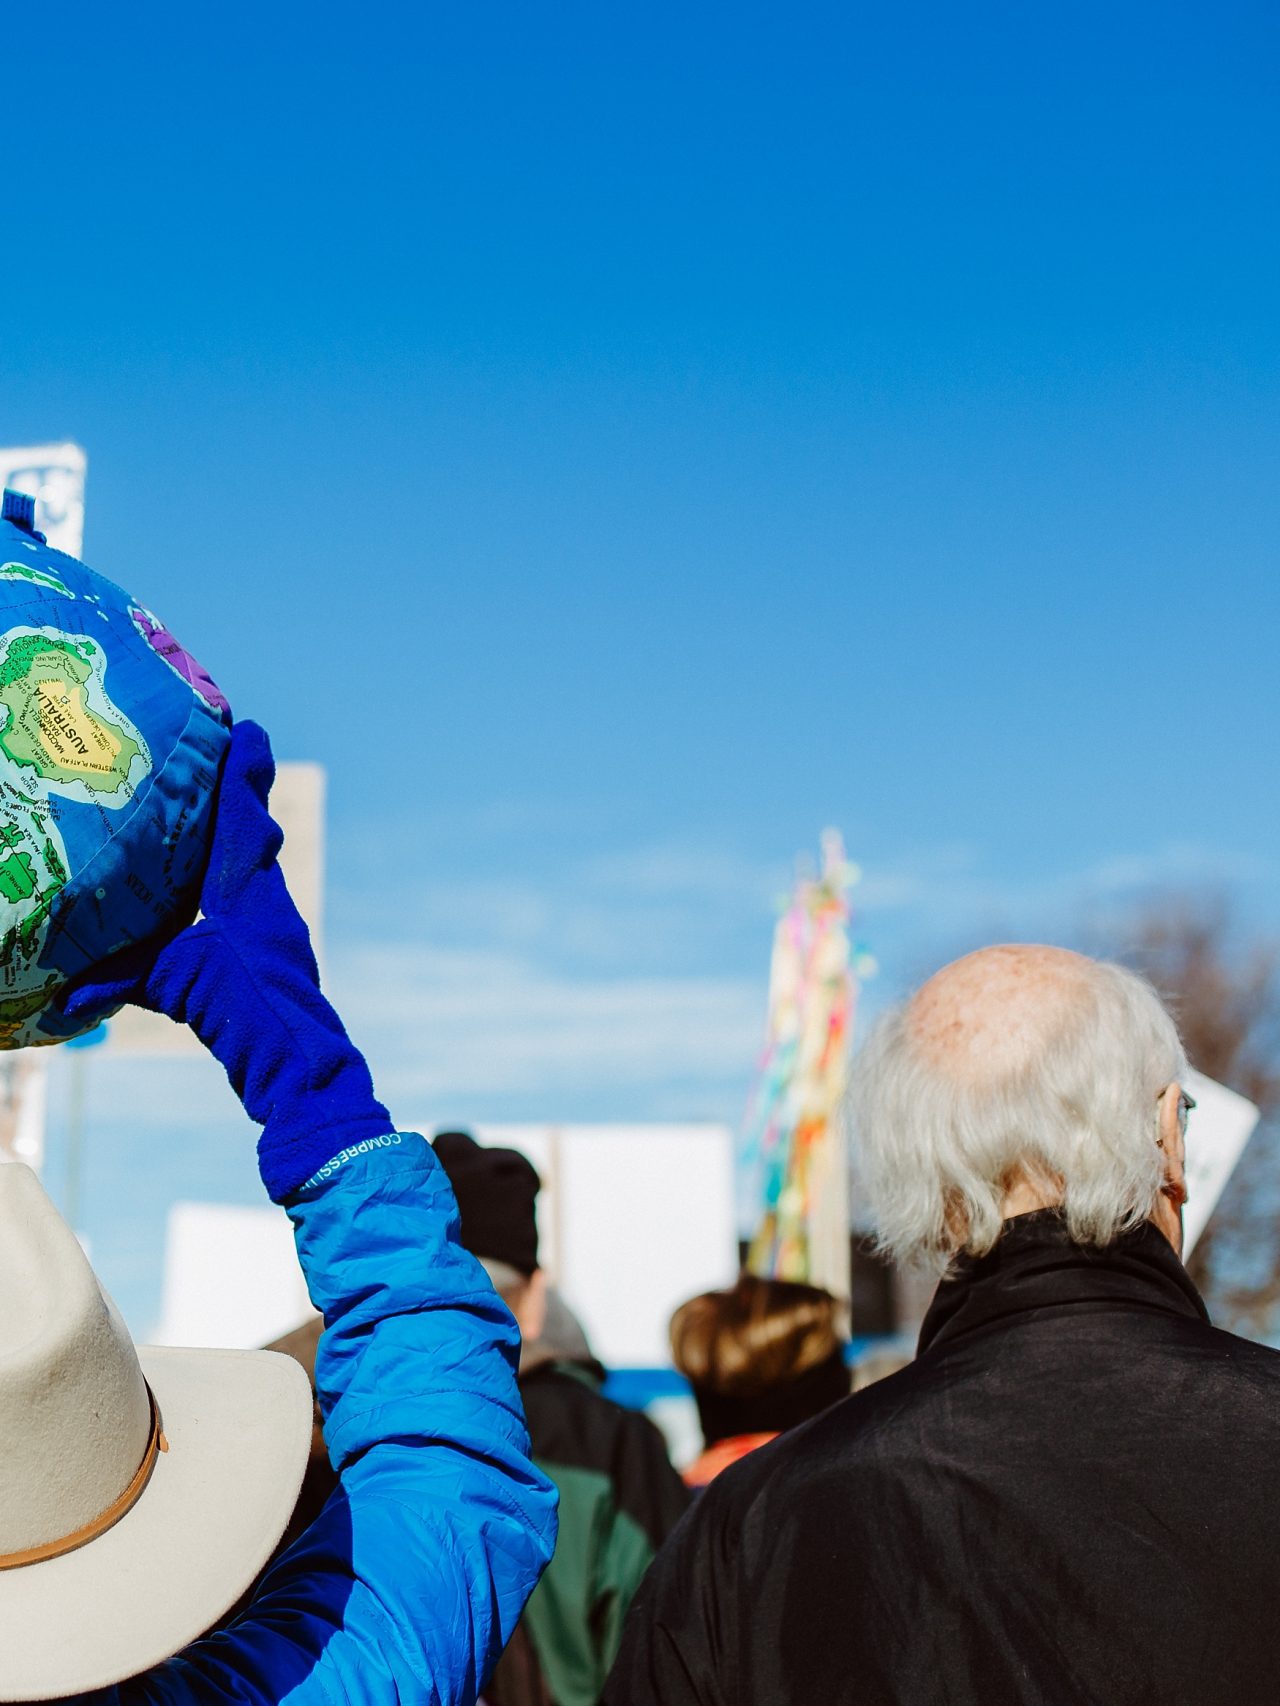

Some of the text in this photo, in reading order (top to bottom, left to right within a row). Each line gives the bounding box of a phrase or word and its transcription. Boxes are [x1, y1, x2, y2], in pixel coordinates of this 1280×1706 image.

[28, 707, 66, 754] MACDONNELL
[32, 687, 89, 755] AUSTRALIA
[38, 708, 62, 737] RANGES
[22, 724, 57, 769] SANDY DESERT
[90, 731, 107, 752] GREAT
[31, 748, 49, 769] GREAT
[60, 756, 118, 774] WESTERN PLATEAU
[19, 775, 36, 796] TIMOR
[28, 775, 40, 789] SEA
[83, 781, 96, 798] CAPE
[1, 808, 19, 822] BURU
[5, 801, 31, 814] FLORES
[23, 827, 43, 856] JAVA SEA
[5, 869, 26, 896] BORNEO
